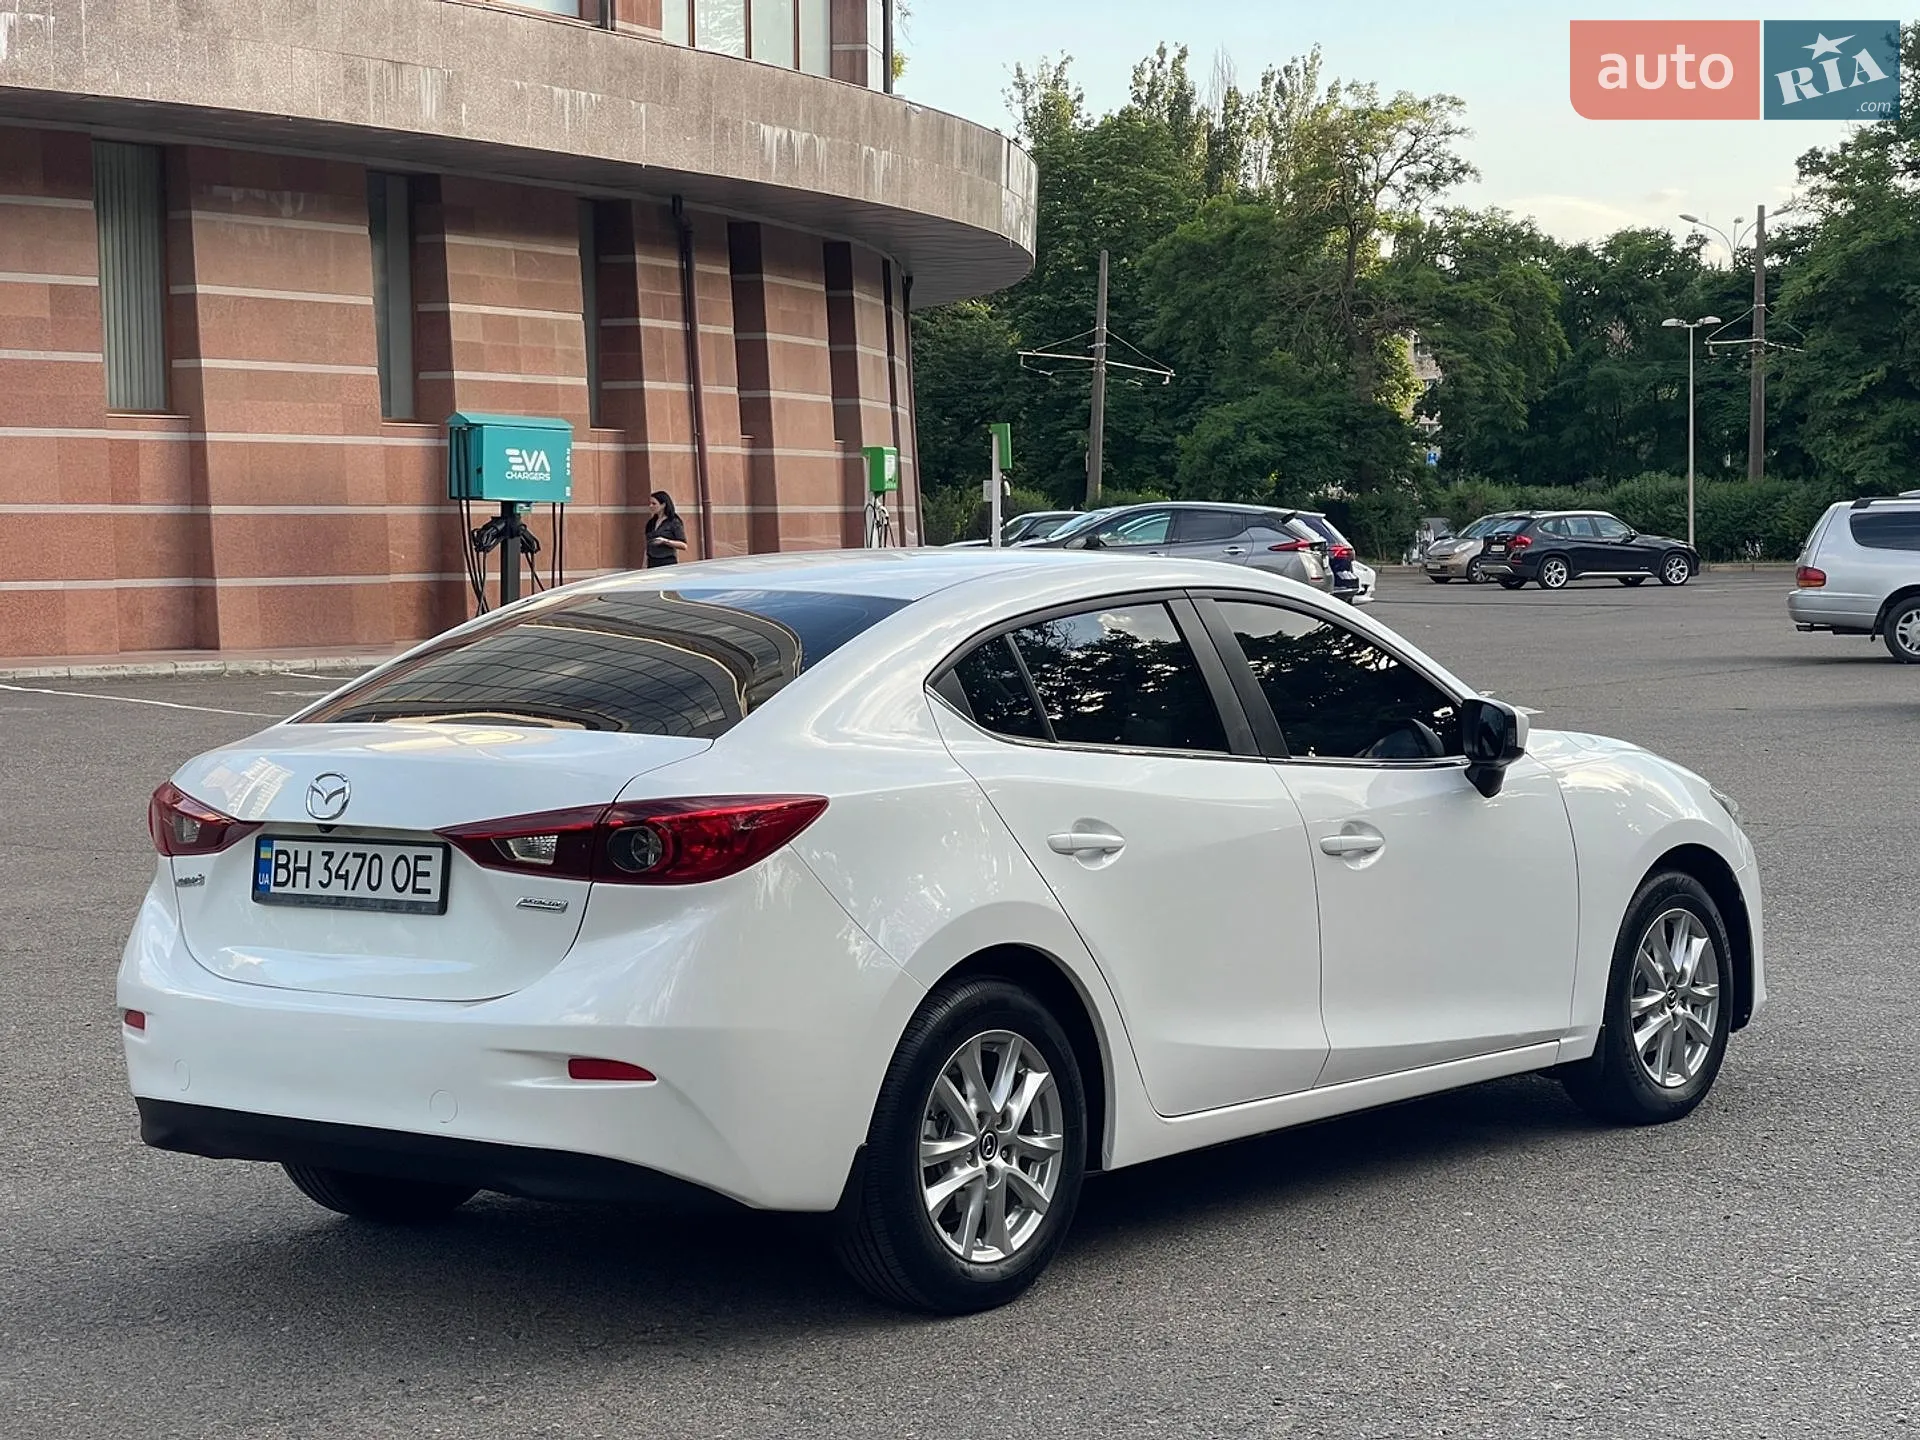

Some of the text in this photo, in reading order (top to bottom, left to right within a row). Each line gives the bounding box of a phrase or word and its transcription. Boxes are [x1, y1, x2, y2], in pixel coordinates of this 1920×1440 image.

[505, 448, 551, 472] EVA
[505, 471, 551, 481] CHARGERS
[258, 872, 270, 885] UA
[272, 849, 433, 895] BH 3470 OE
